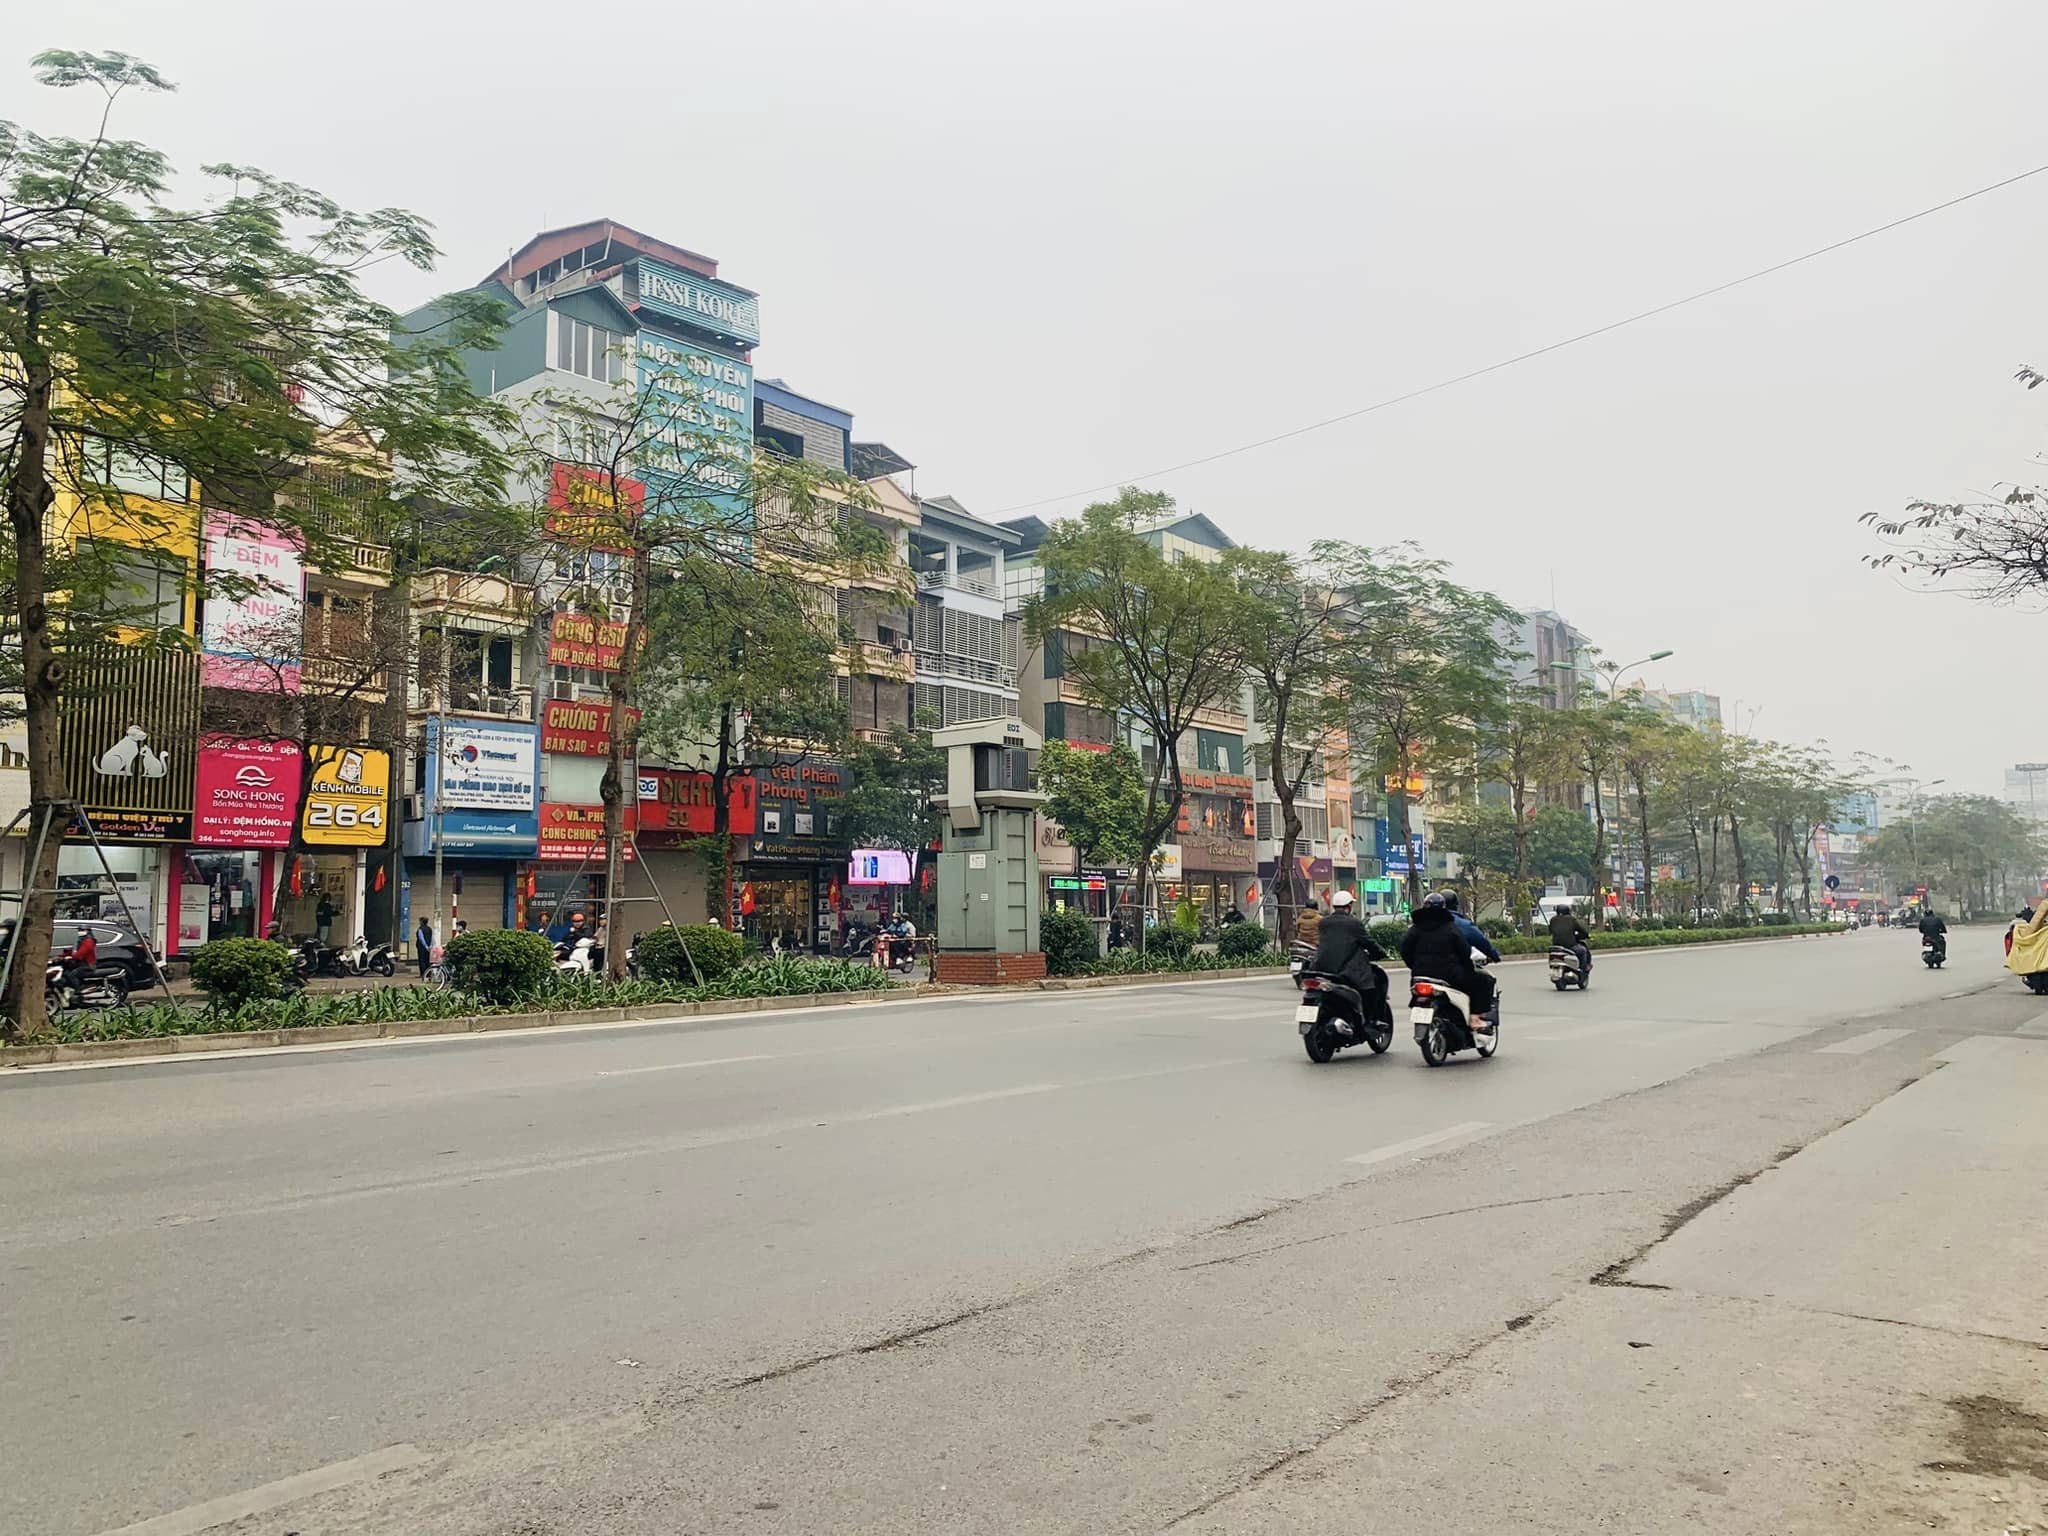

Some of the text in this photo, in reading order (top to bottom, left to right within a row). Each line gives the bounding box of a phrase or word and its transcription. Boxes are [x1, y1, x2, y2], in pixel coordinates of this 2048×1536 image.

[548, 703, 597, 732] CHỨNG
[545, 733, 565, 751] BẢN
[567, 739, 587, 753] SAO
[213, 788, 285, 802] SONG HONG
[311, 780, 385, 795] KÊNH MOBILE
[760, 782, 808, 803] Phong
[309, 802, 383, 828] 264
[99, 822, 141, 831] Golden
